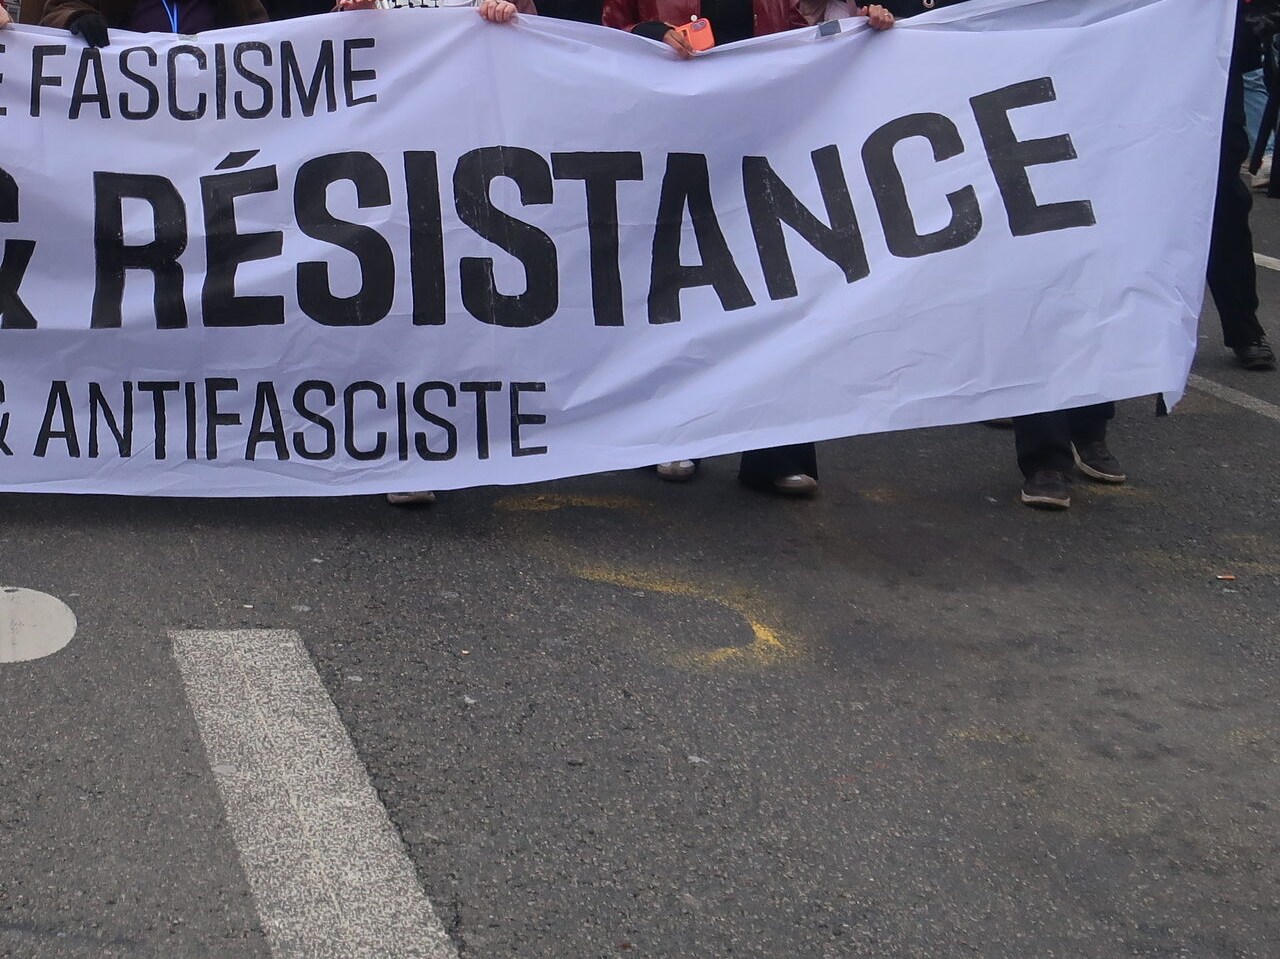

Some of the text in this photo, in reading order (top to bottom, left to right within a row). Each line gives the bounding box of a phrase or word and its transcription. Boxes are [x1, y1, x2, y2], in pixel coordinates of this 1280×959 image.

[31, 38, 377, 119] FASCISME
[92, 77, 1096, 329] RÉSISTANCE
[34, 377, 549, 461] ANTIFASCISTE
